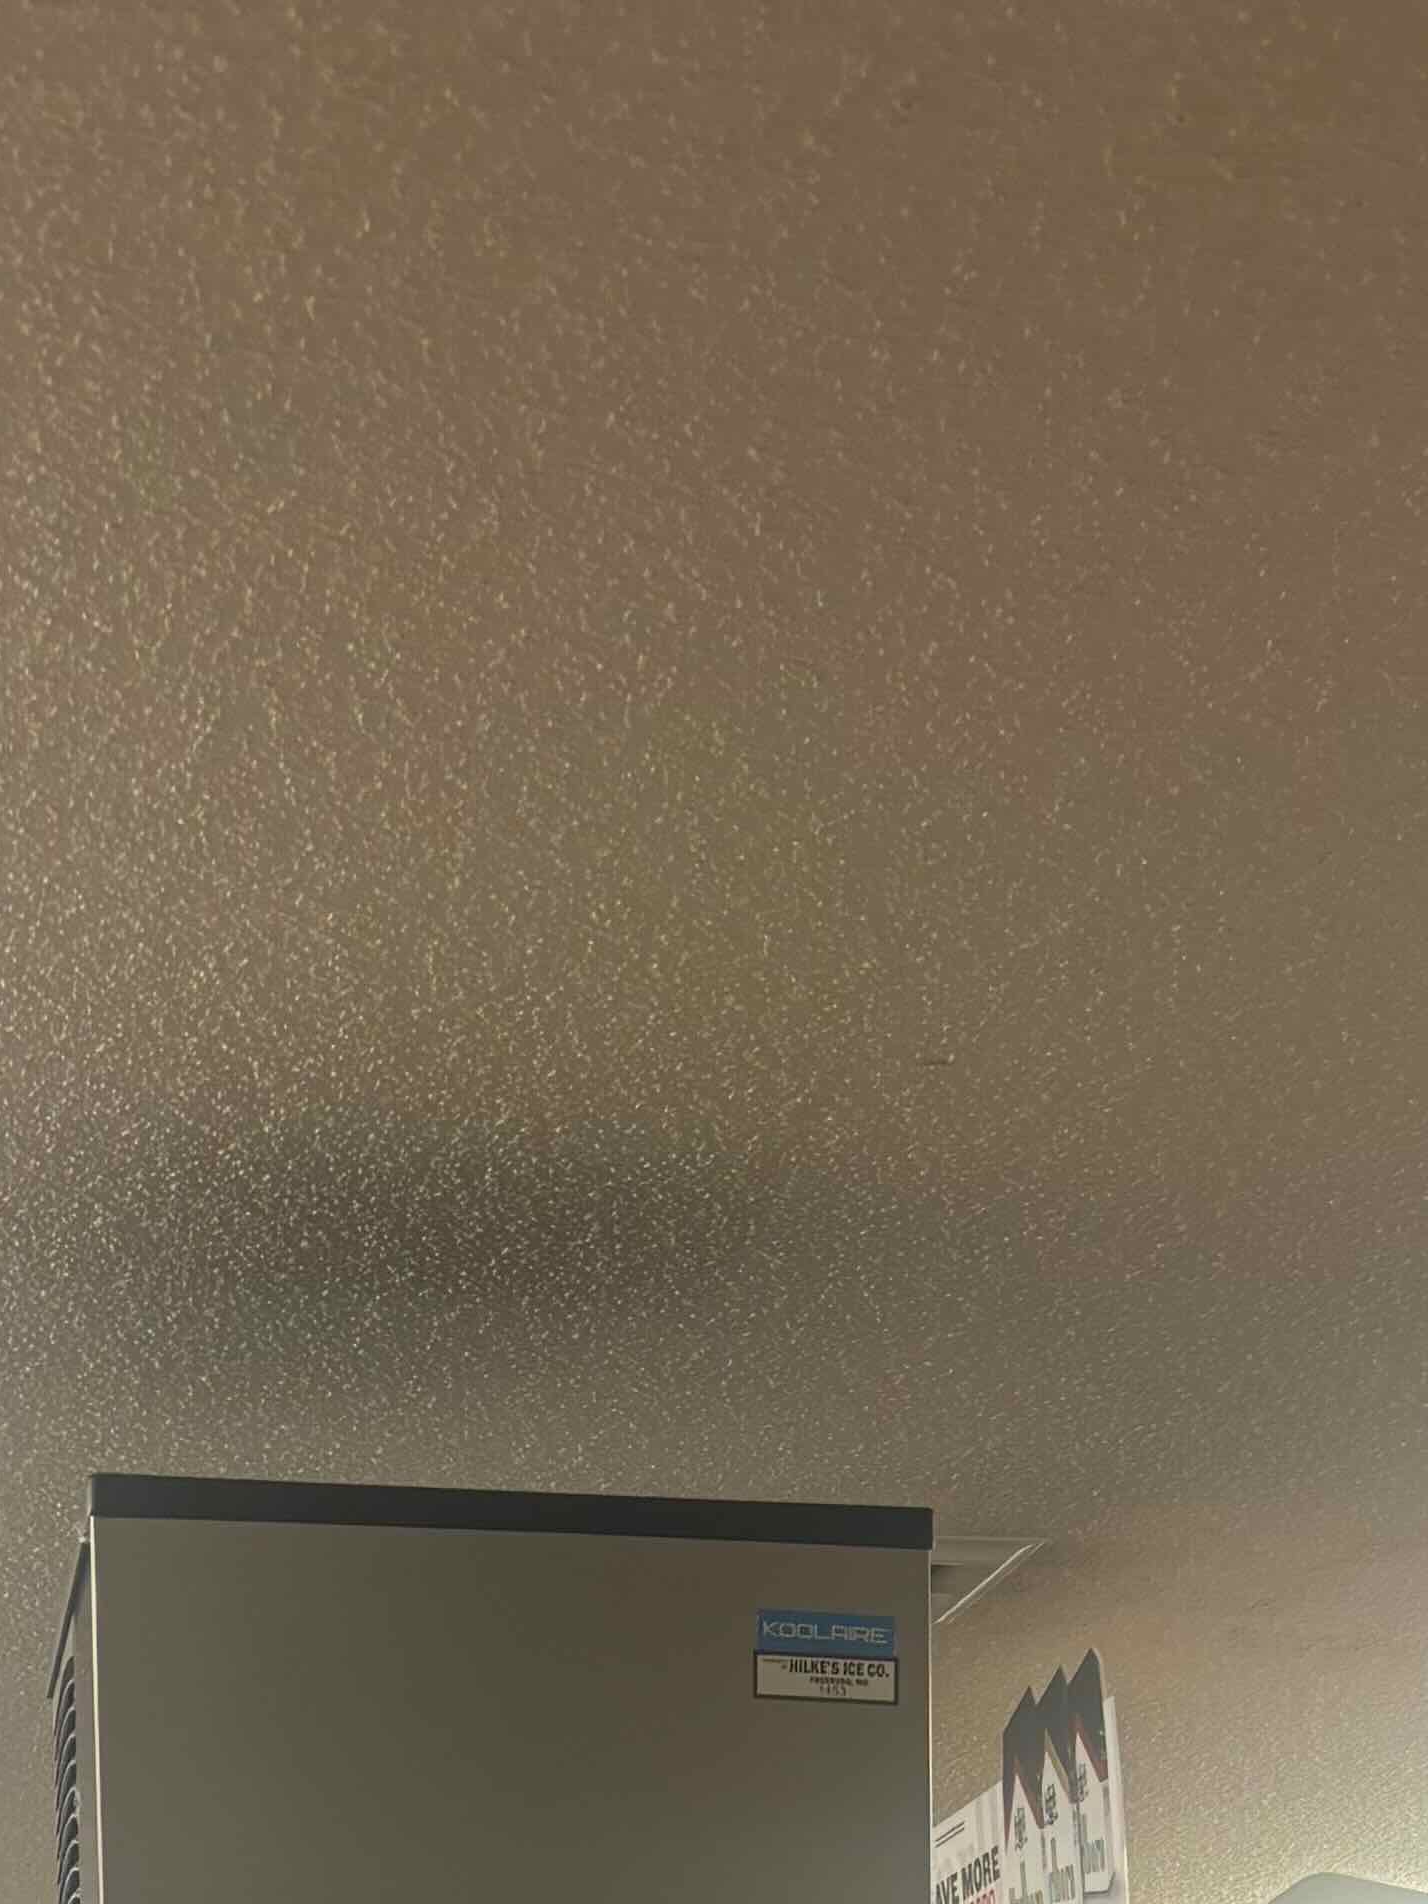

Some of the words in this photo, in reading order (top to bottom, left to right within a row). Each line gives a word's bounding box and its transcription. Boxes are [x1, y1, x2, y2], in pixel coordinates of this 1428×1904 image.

[762, 1620, 889, 1644] KOOLAIRE
[789, 1658, 840, 1675] HILKE'S
[843, 1662, 865, 1676] ICE
[867, 1663, 890, 1679] CO.
[961, 1845, 1001, 1897] MORE
